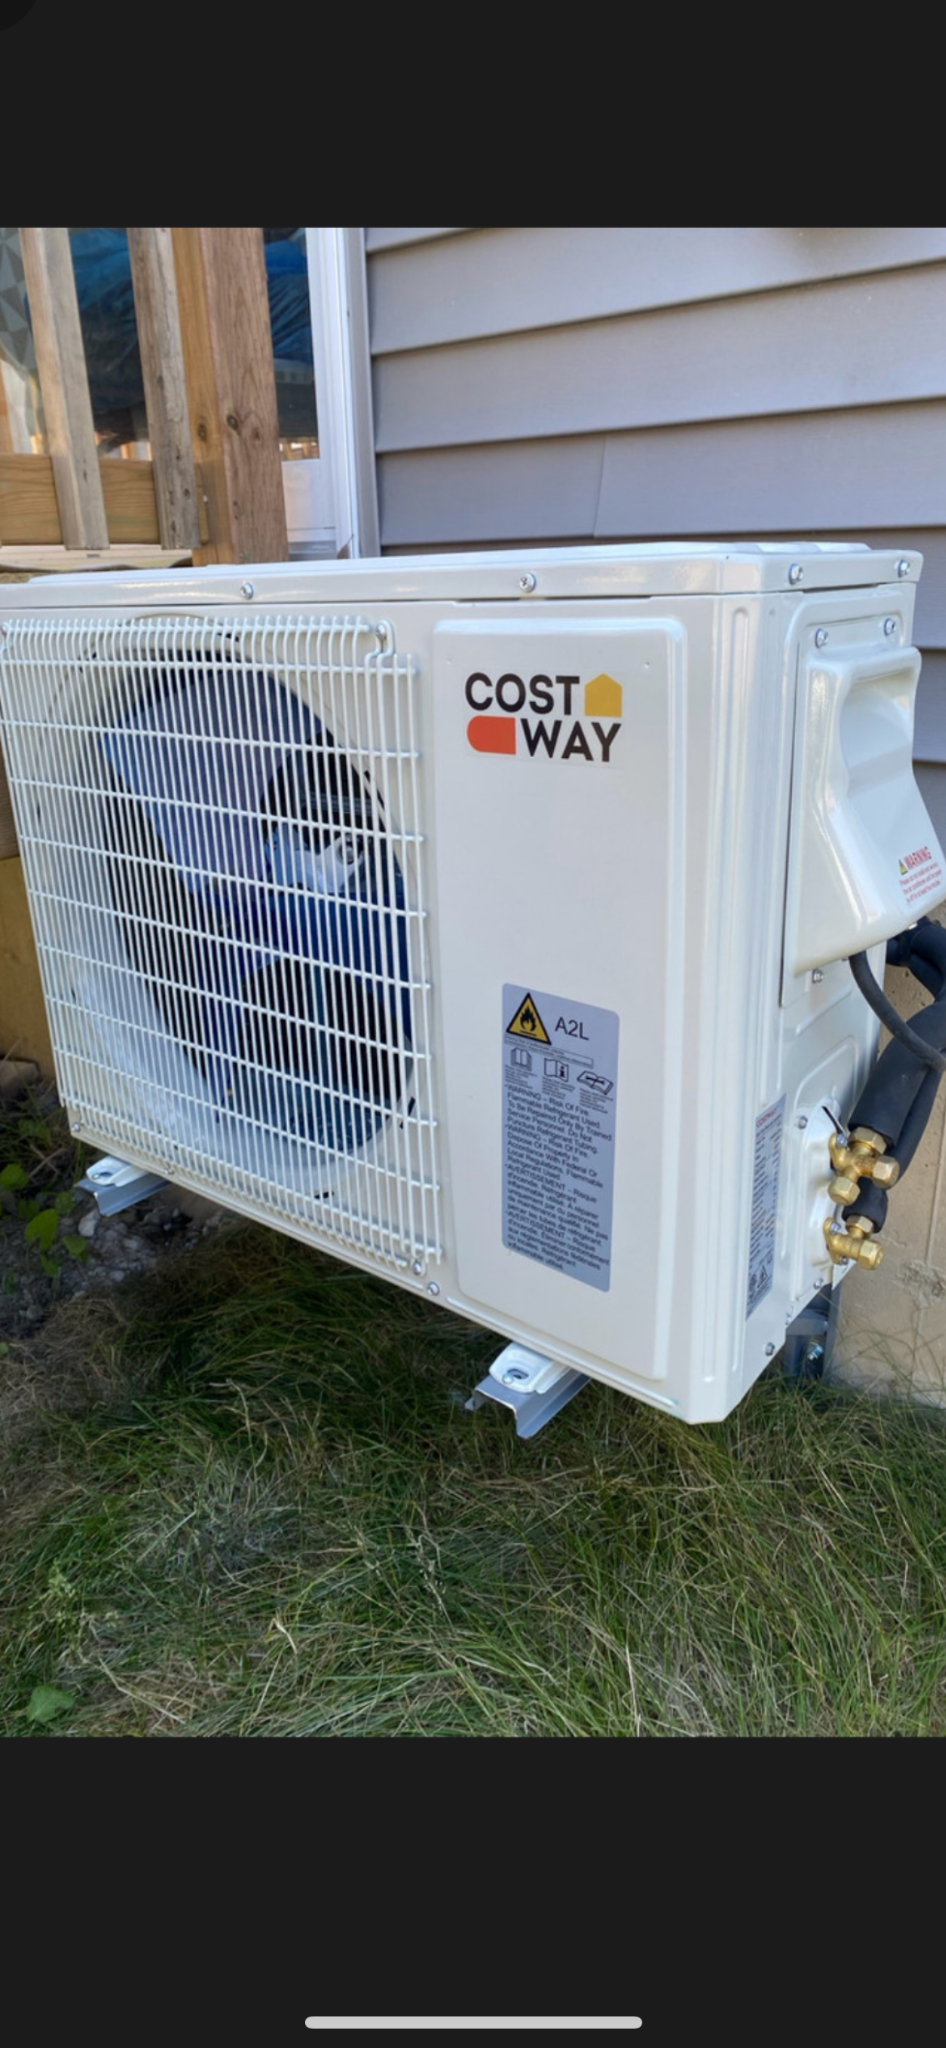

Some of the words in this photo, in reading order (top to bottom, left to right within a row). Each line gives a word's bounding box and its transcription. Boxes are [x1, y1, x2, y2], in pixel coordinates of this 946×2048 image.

[465, 672, 580, 716] COST
[520, 718, 622, 762] WAY
[904, 845, 932, 870] WARNING
[554, 1016, 590, 1041] A2L
[507, 1091, 541, 1108] Flammable
[543, 1103, 579, 1123] Refrigerant
[548, 1097, 562, 1107] Risk
[507, 1108, 530, 1120] Service
[527, 1106, 555, 1123] Repaired
[537, 1126, 572, 1146] Refrigerant
[548, 1138, 562, 1148] Risk
[507, 1139, 543, 1157] Accordance
[507, 1155, 540, 1174] Refrigerant
[566, 1169, 603, 1188] Flammable
